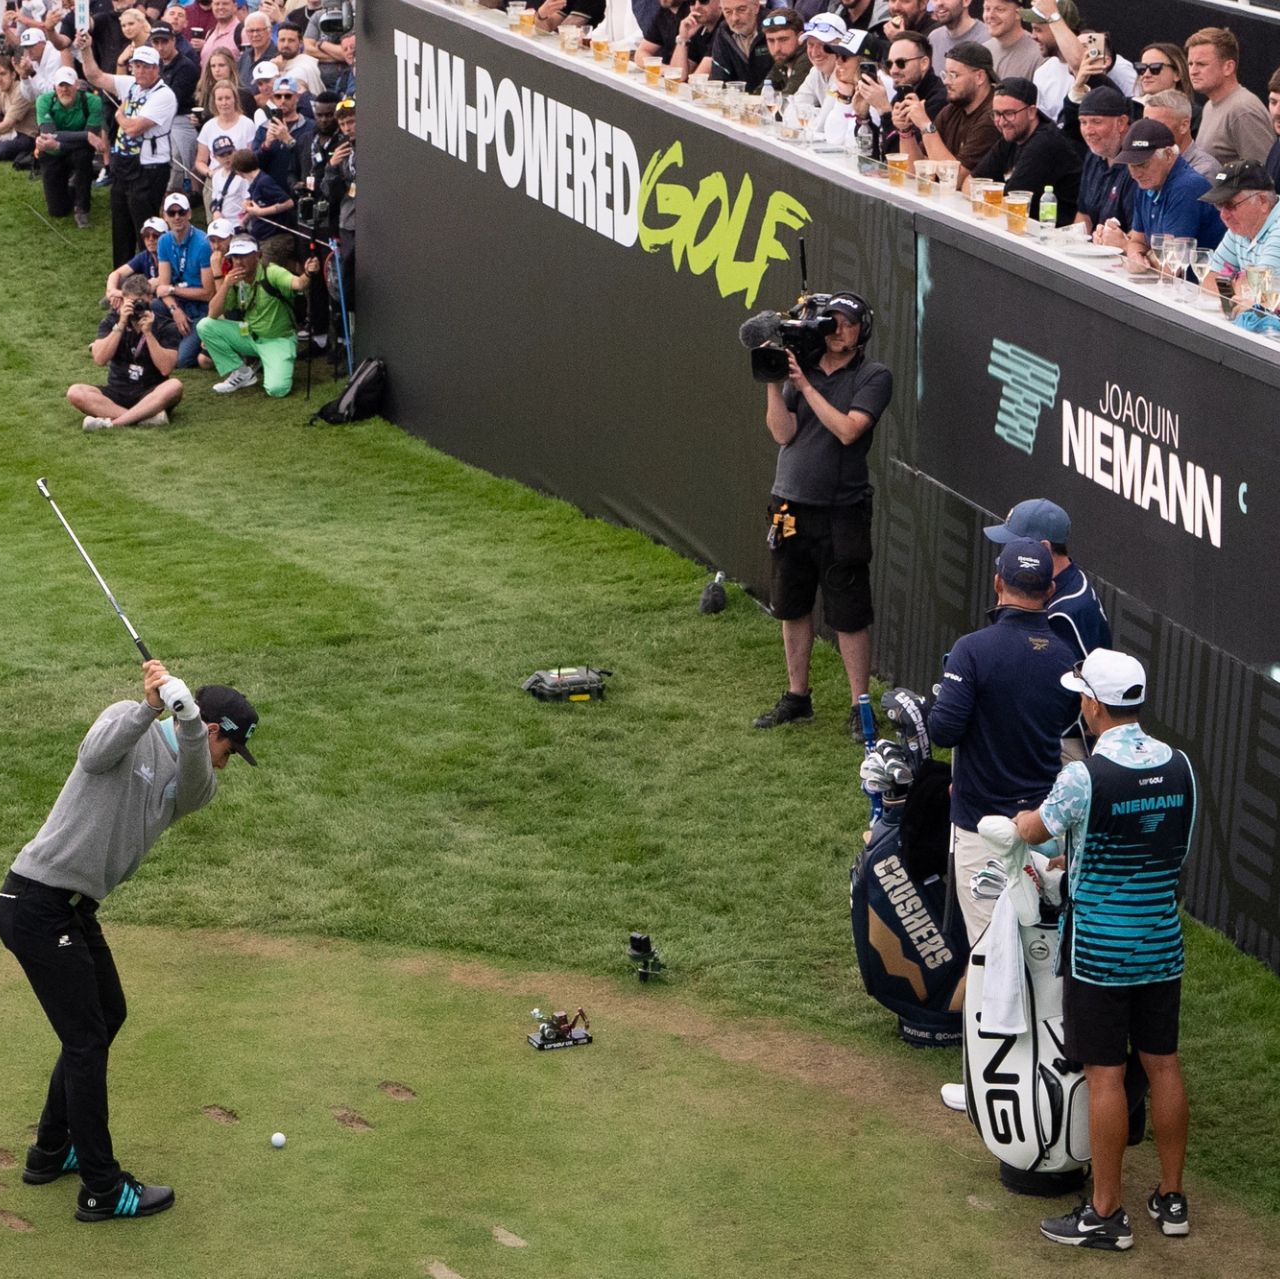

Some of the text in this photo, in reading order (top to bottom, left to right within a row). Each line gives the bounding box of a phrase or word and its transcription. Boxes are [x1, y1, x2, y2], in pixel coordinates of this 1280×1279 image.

[392, 29, 813, 310] TEAM-POWERED GOLF
[1061, 398, 1222, 549] NIEMANN
[1099, 380, 1180, 449] JOAQUIN
[873, 854, 953, 970] CRUSHERS
